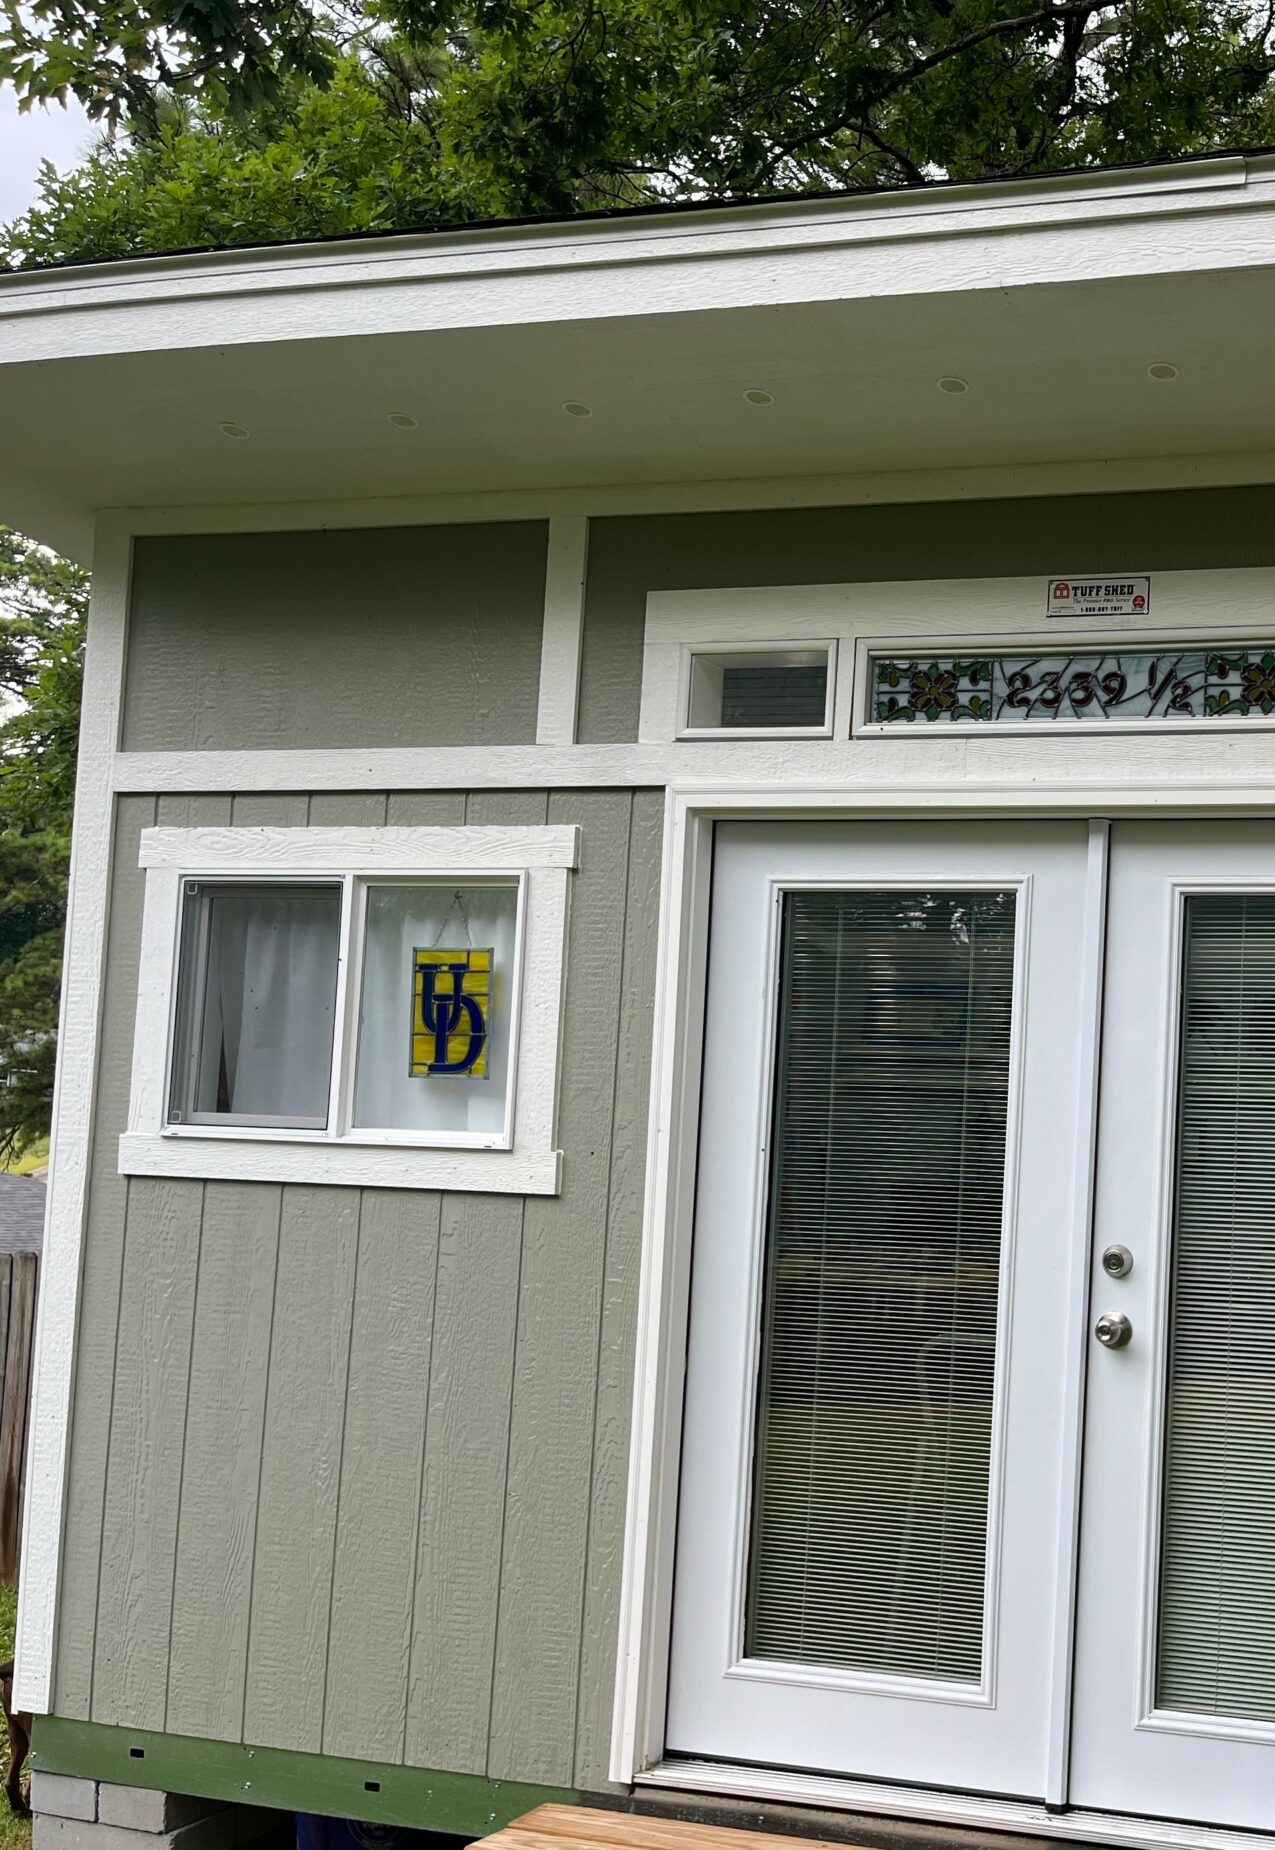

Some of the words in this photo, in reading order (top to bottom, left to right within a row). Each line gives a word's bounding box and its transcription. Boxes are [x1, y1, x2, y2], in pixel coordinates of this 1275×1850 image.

[1072, 585, 1102, 597] TUFF
[1103, 584, 1134, 596] SHED
[1006, 670, 1127, 708] 2339
